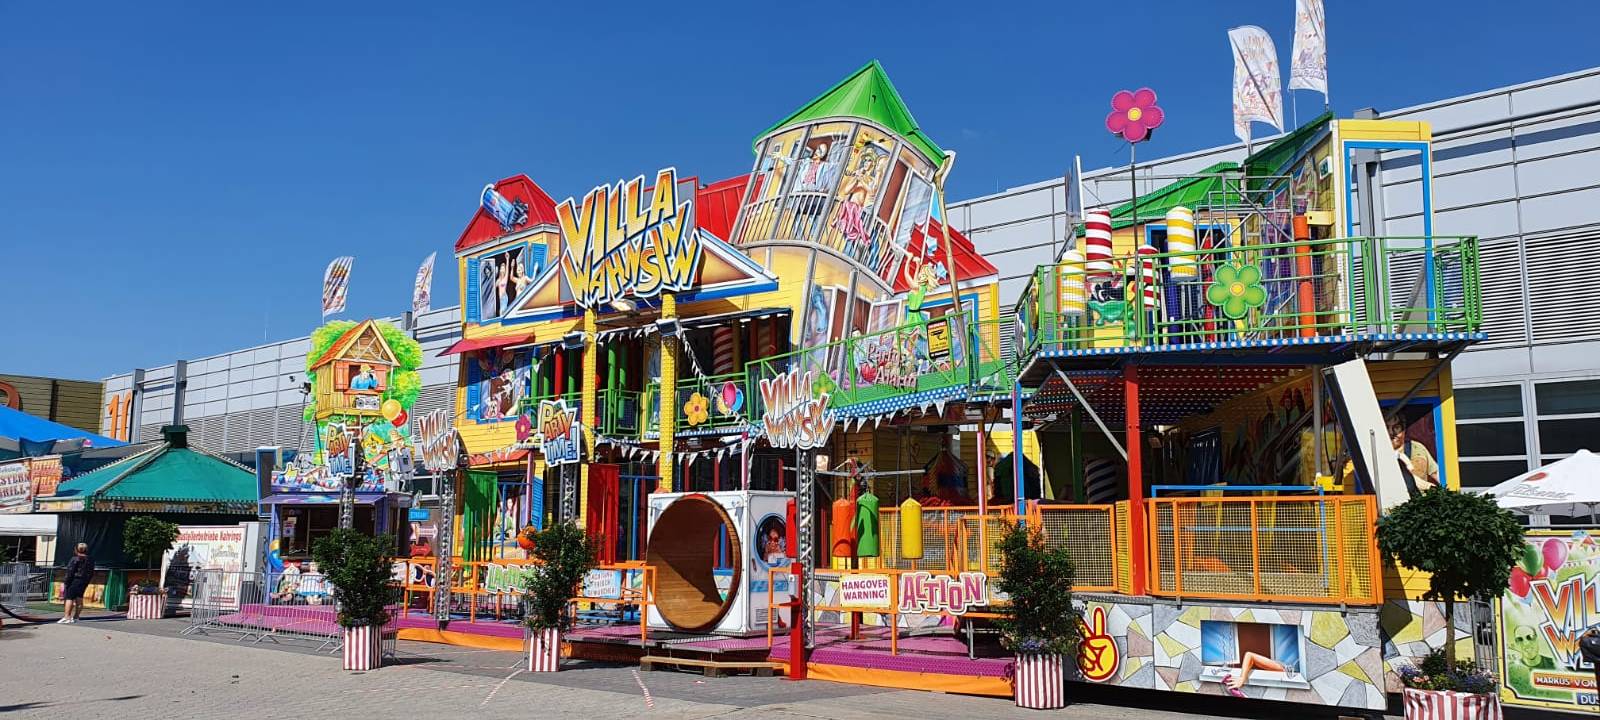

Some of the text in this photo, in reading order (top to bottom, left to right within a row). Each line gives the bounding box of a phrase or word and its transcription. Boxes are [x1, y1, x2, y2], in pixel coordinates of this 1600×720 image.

[556, 168, 677, 269] VILLA
[562, 201, 701, 305] WAHNSINN
[760, 369, 812, 420] VILLA
[419, 410, 448, 448] VILLA
[540, 401, 578, 441] PARTY
[326, 424, 352, 459] PARTY
[841, 578, 888, 592] HANGOVER
[843, 588, 888, 601] WARNING!
[902, 573, 986, 614] ACTION
[1536, 676, 1598, 688] MARKUS VON
